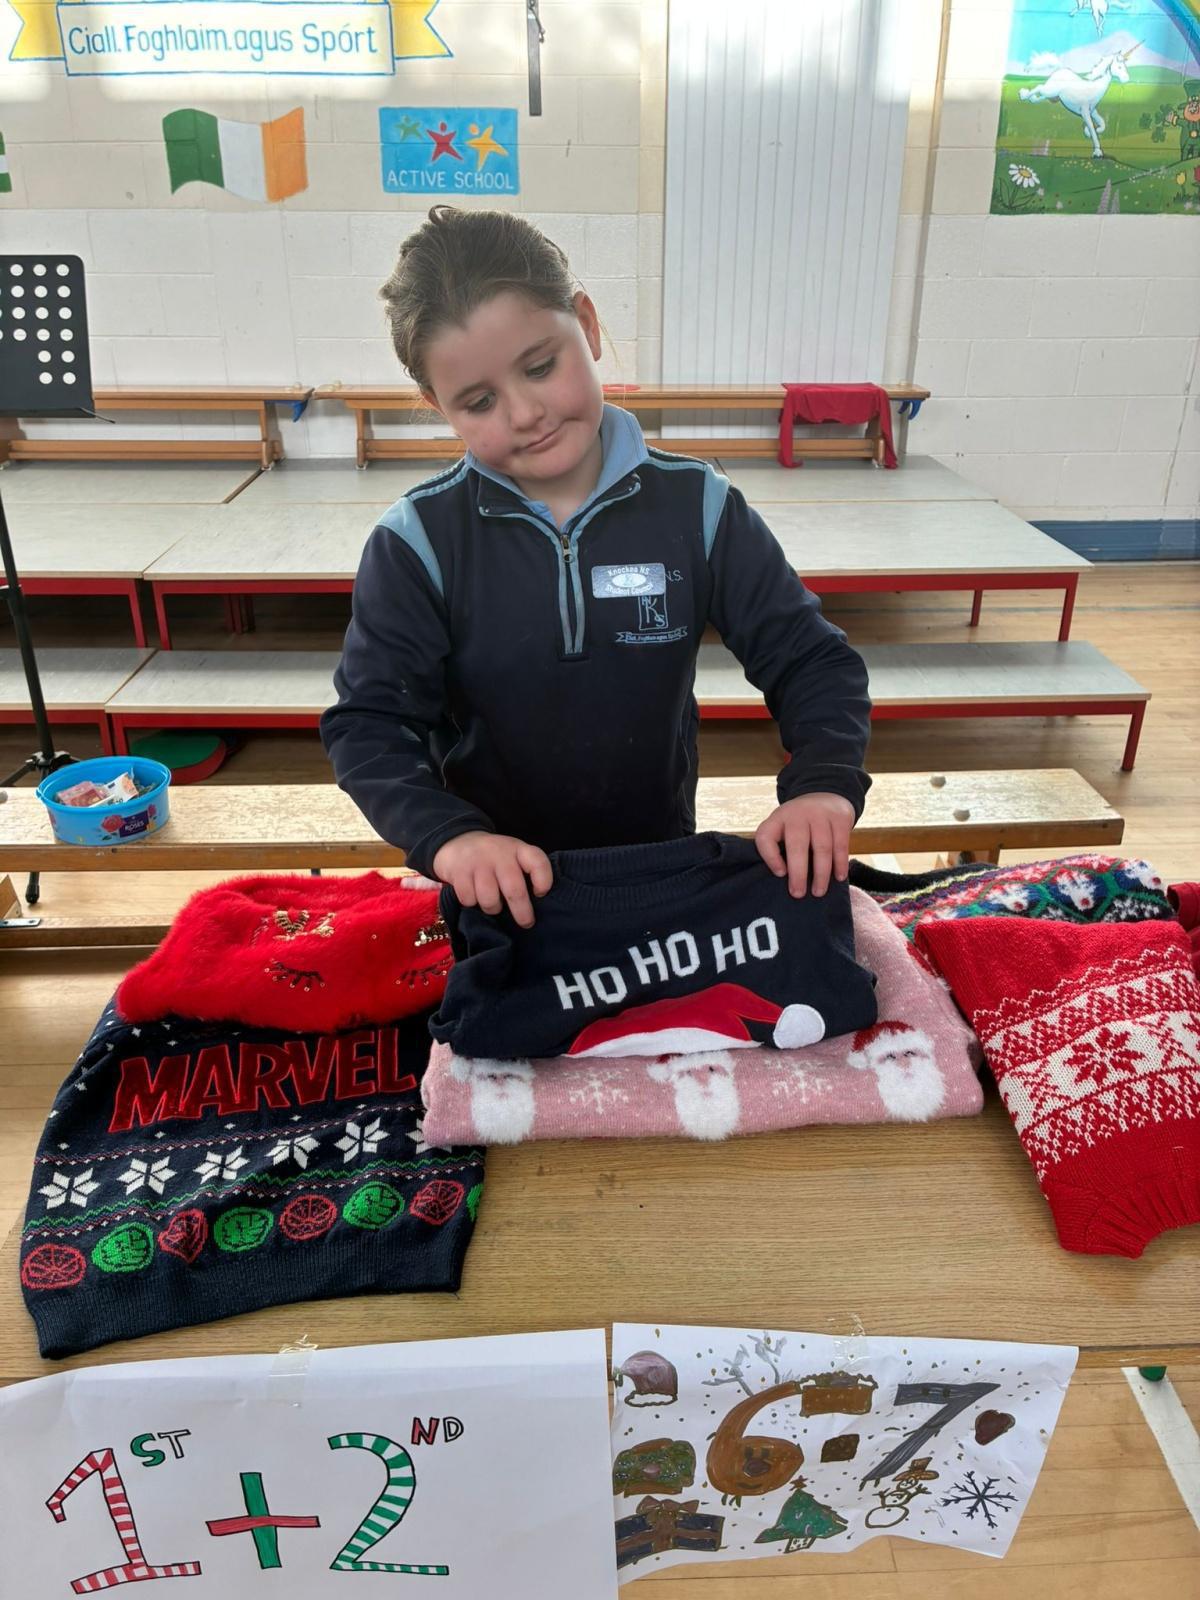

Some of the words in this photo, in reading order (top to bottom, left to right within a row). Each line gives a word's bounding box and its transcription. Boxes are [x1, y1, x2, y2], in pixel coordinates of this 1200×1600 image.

[302, 22, 378, 62] Spórt
[386, 169, 447, 188] ACTIVE
[454, 170, 515, 190] SCHOOL
[639, 565, 651, 576] NS
[552, 966, 628, 1010] HO
[628, 930, 701, 985] HO
[711, 916, 780, 974] HO
[108, 1028, 418, 1134] MARVEL
